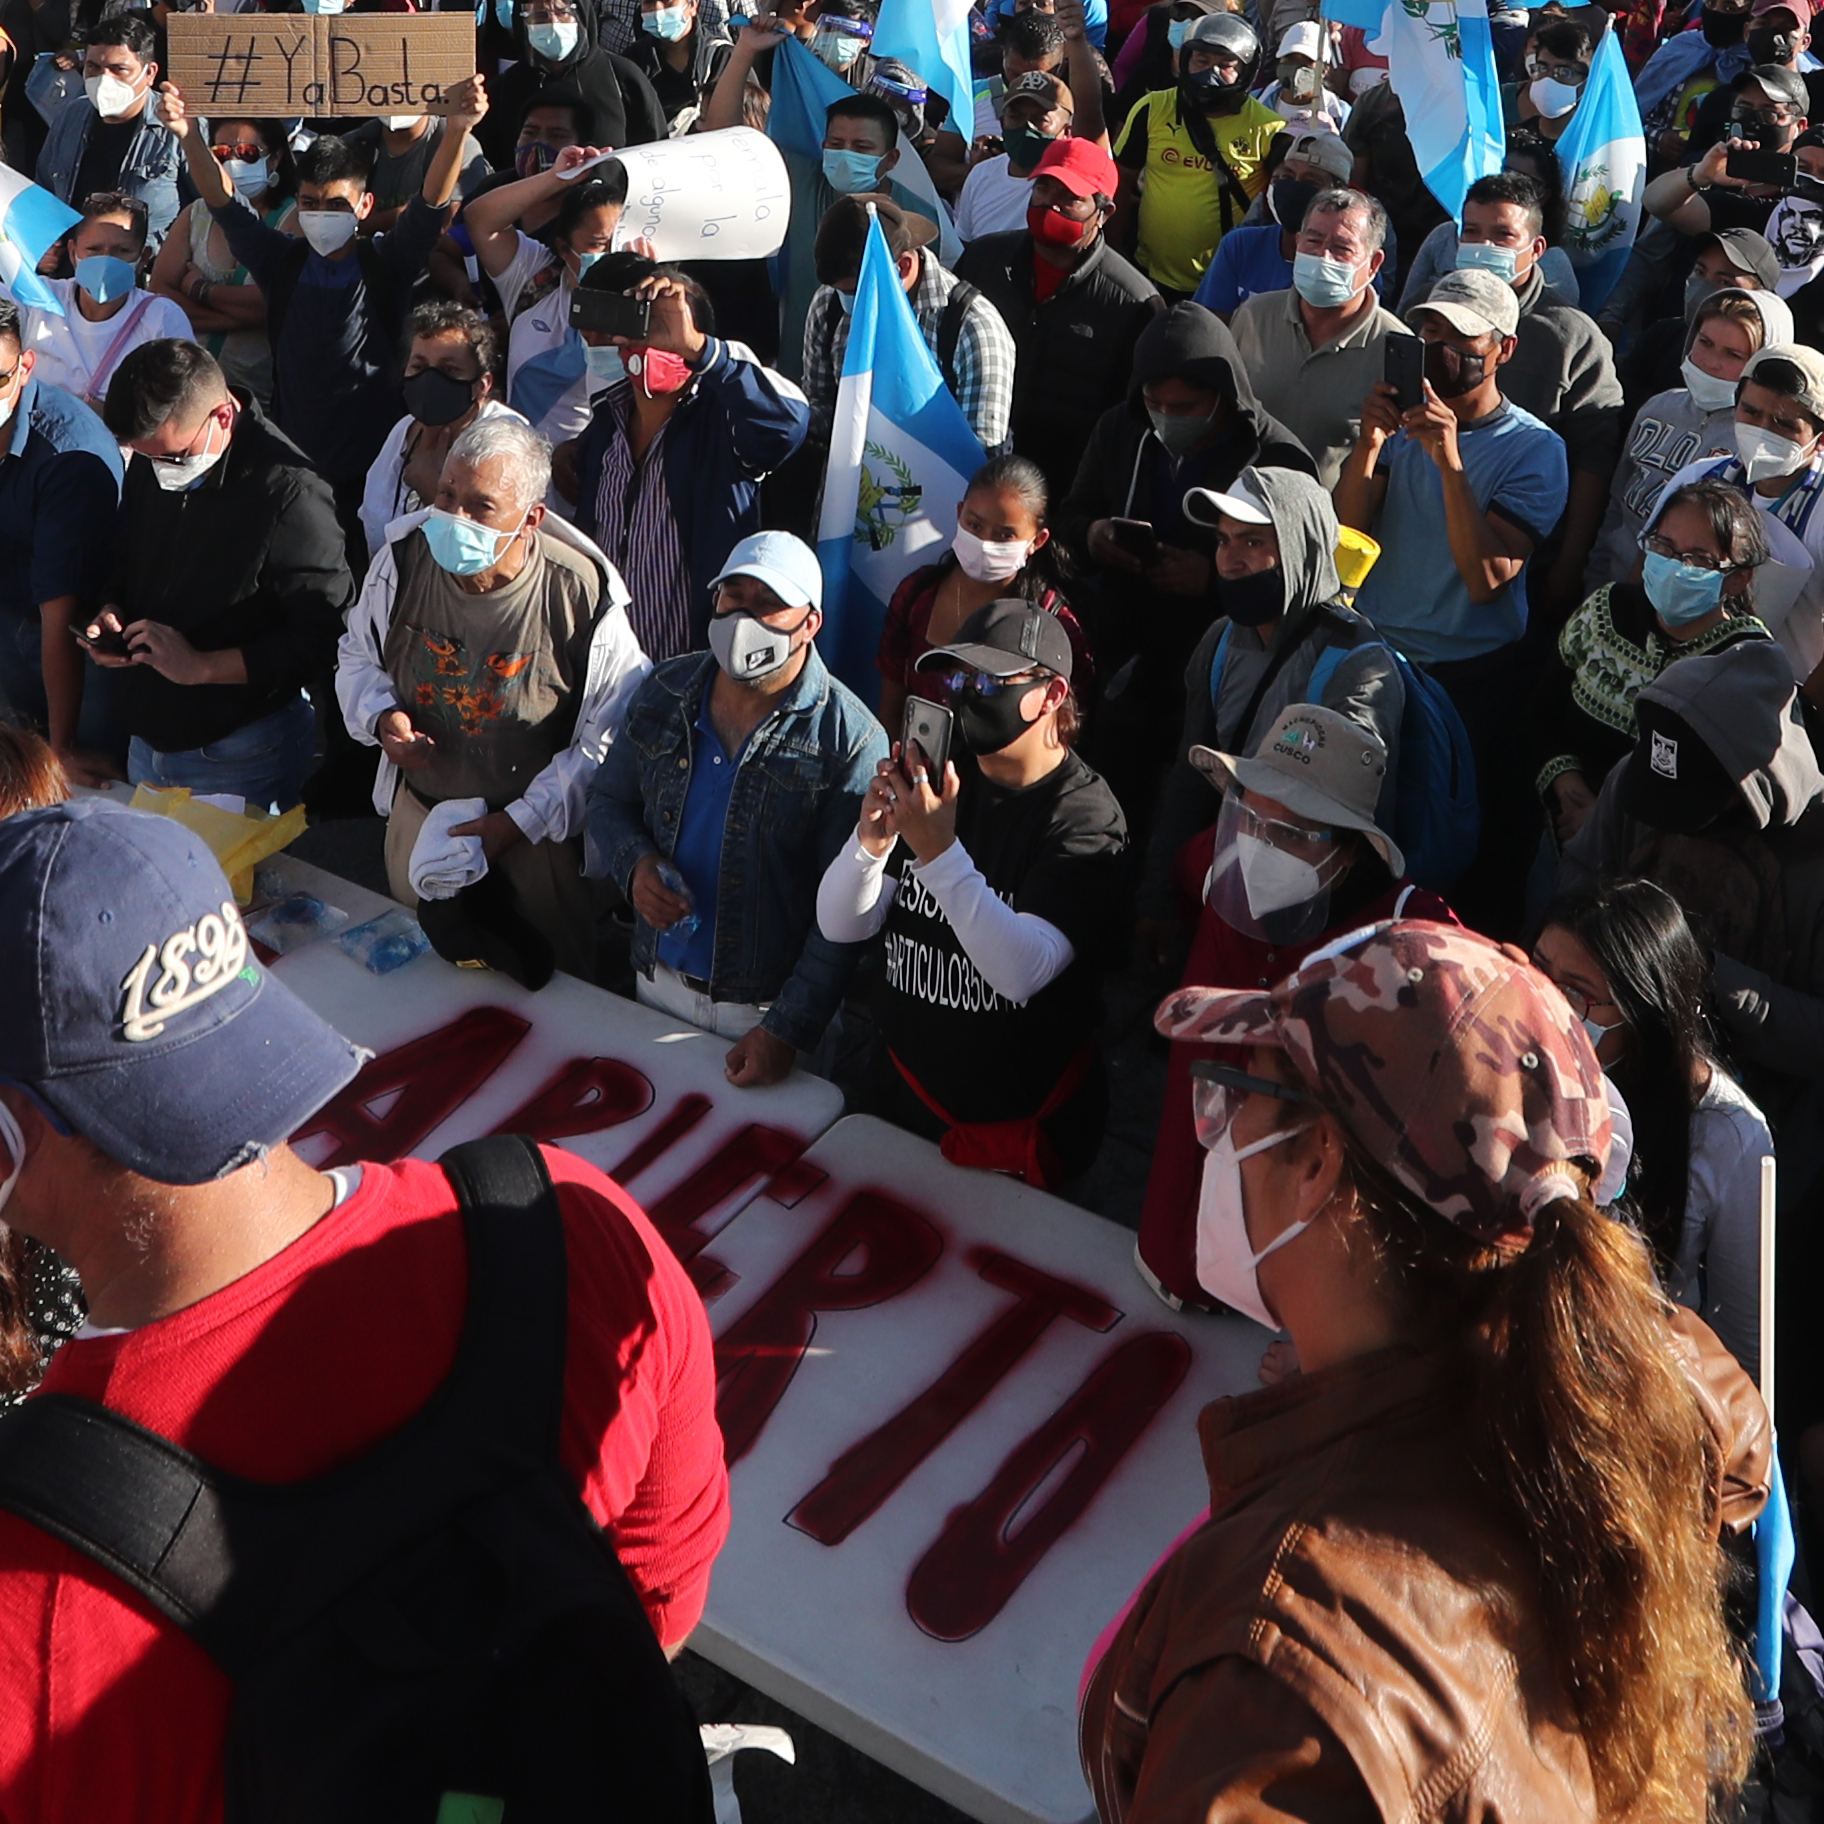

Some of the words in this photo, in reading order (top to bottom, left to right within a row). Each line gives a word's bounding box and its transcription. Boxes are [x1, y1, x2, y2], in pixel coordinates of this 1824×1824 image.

[640, 148, 666, 168] de
[689, 154, 722, 192] por
[701, 215, 737, 238] la
[1273, 741, 1311, 767] CUSCO
